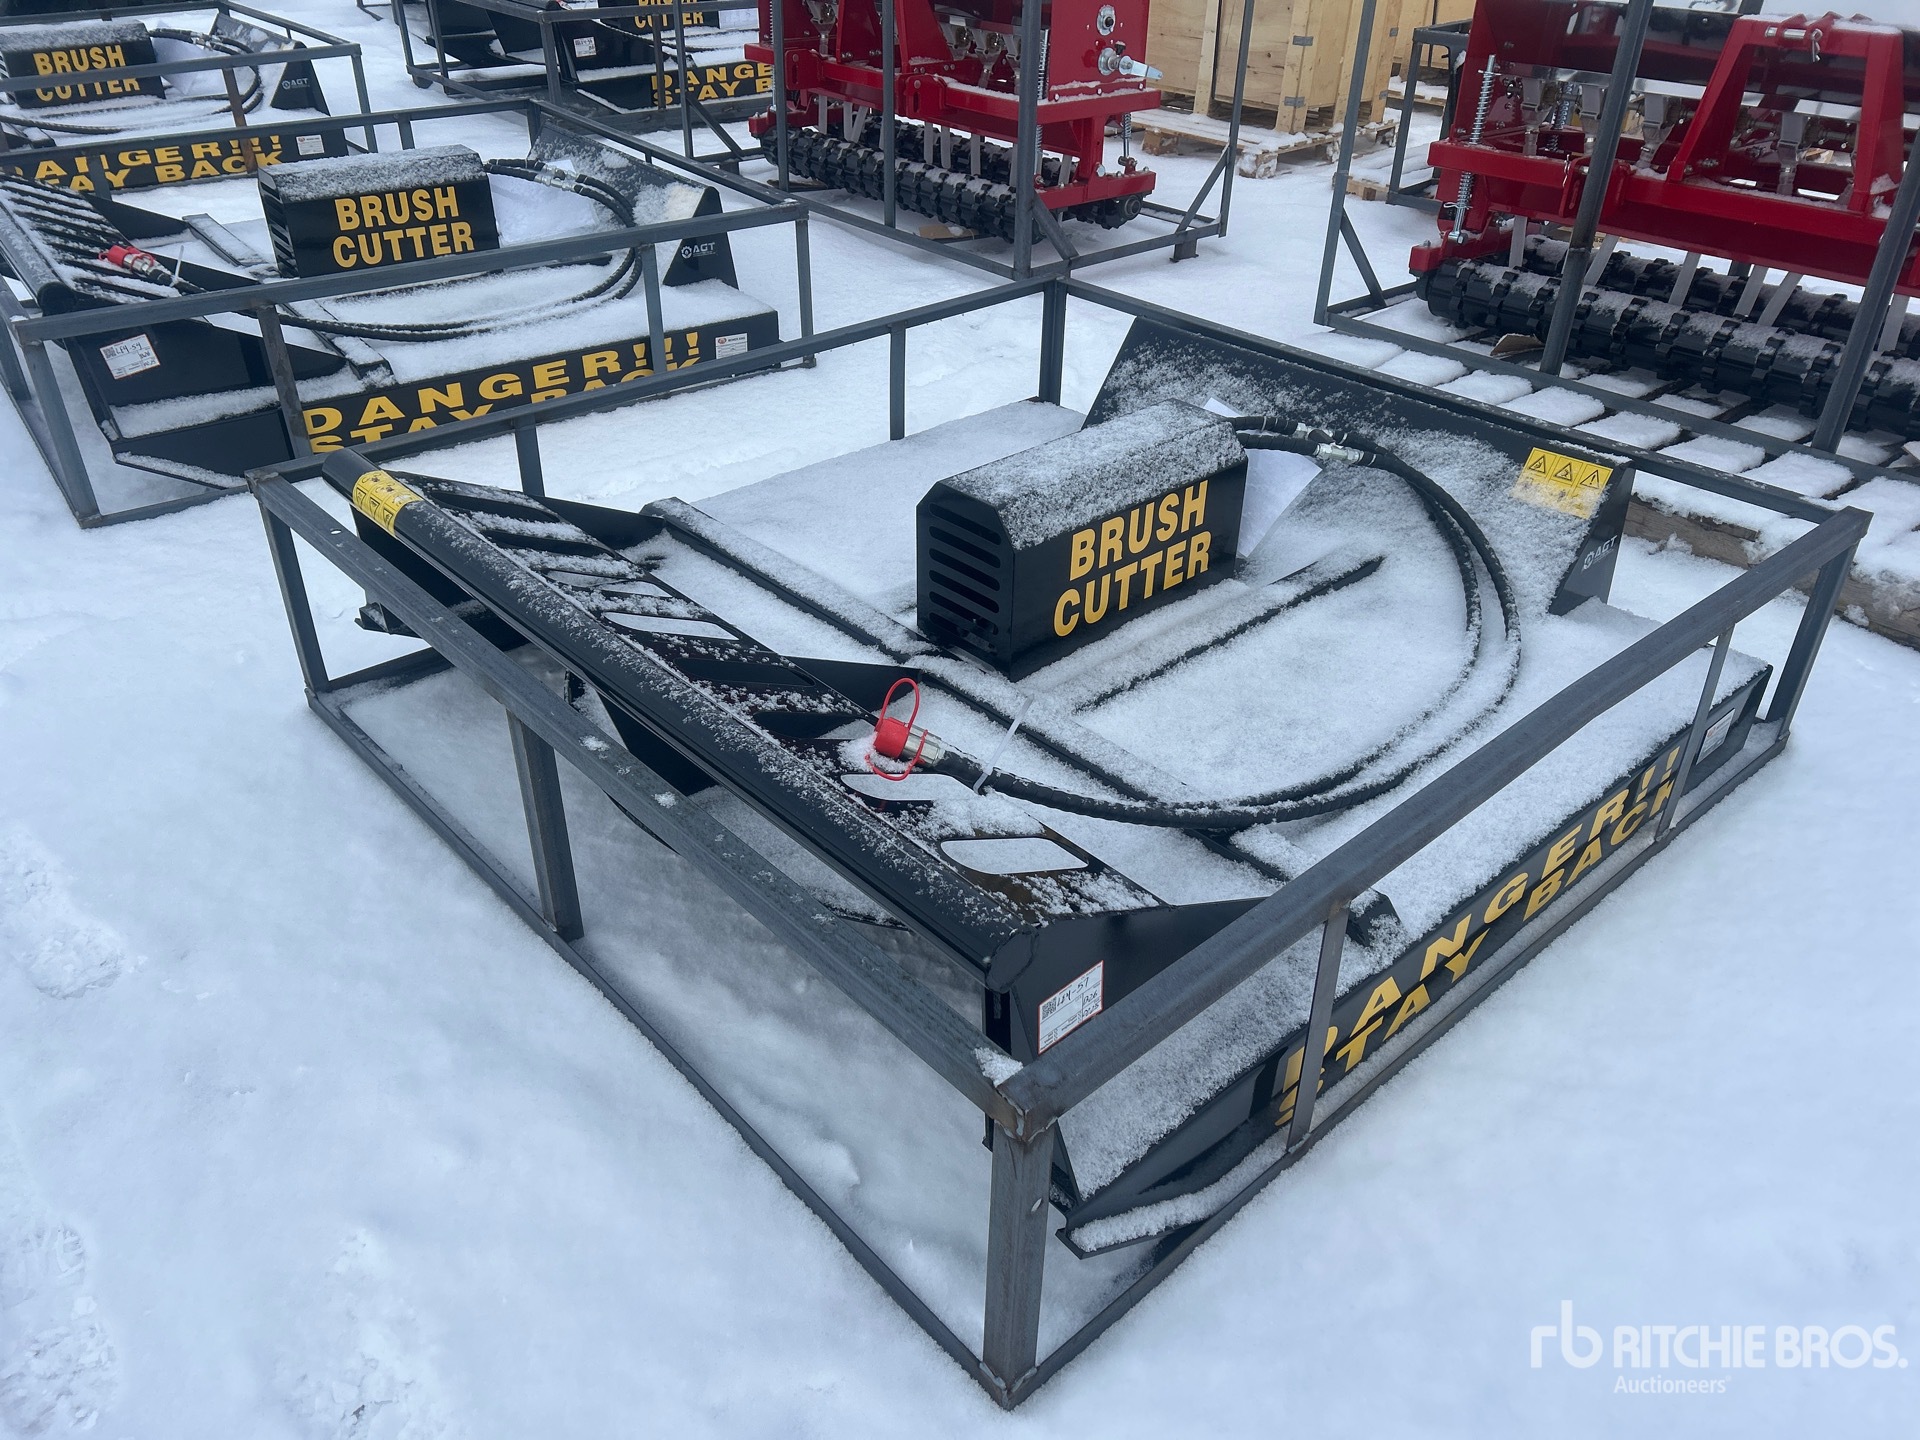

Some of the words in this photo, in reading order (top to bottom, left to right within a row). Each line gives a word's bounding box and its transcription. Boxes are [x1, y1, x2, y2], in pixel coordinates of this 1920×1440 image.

[33, 44, 126, 76] BRUSH
[14, 135, 282, 179] ANGER!!!
[154, 150, 283, 183] BACK
[334, 186, 460, 231] BRUSH
[333, 221, 475, 269] CUTTER
[693, 242, 716, 253] AGT
[303, 331, 700, 435] DANGER!!!
[1070, 479, 1209, 582] BRUSH
[1053, 530, 1212, 637] CUTTER
